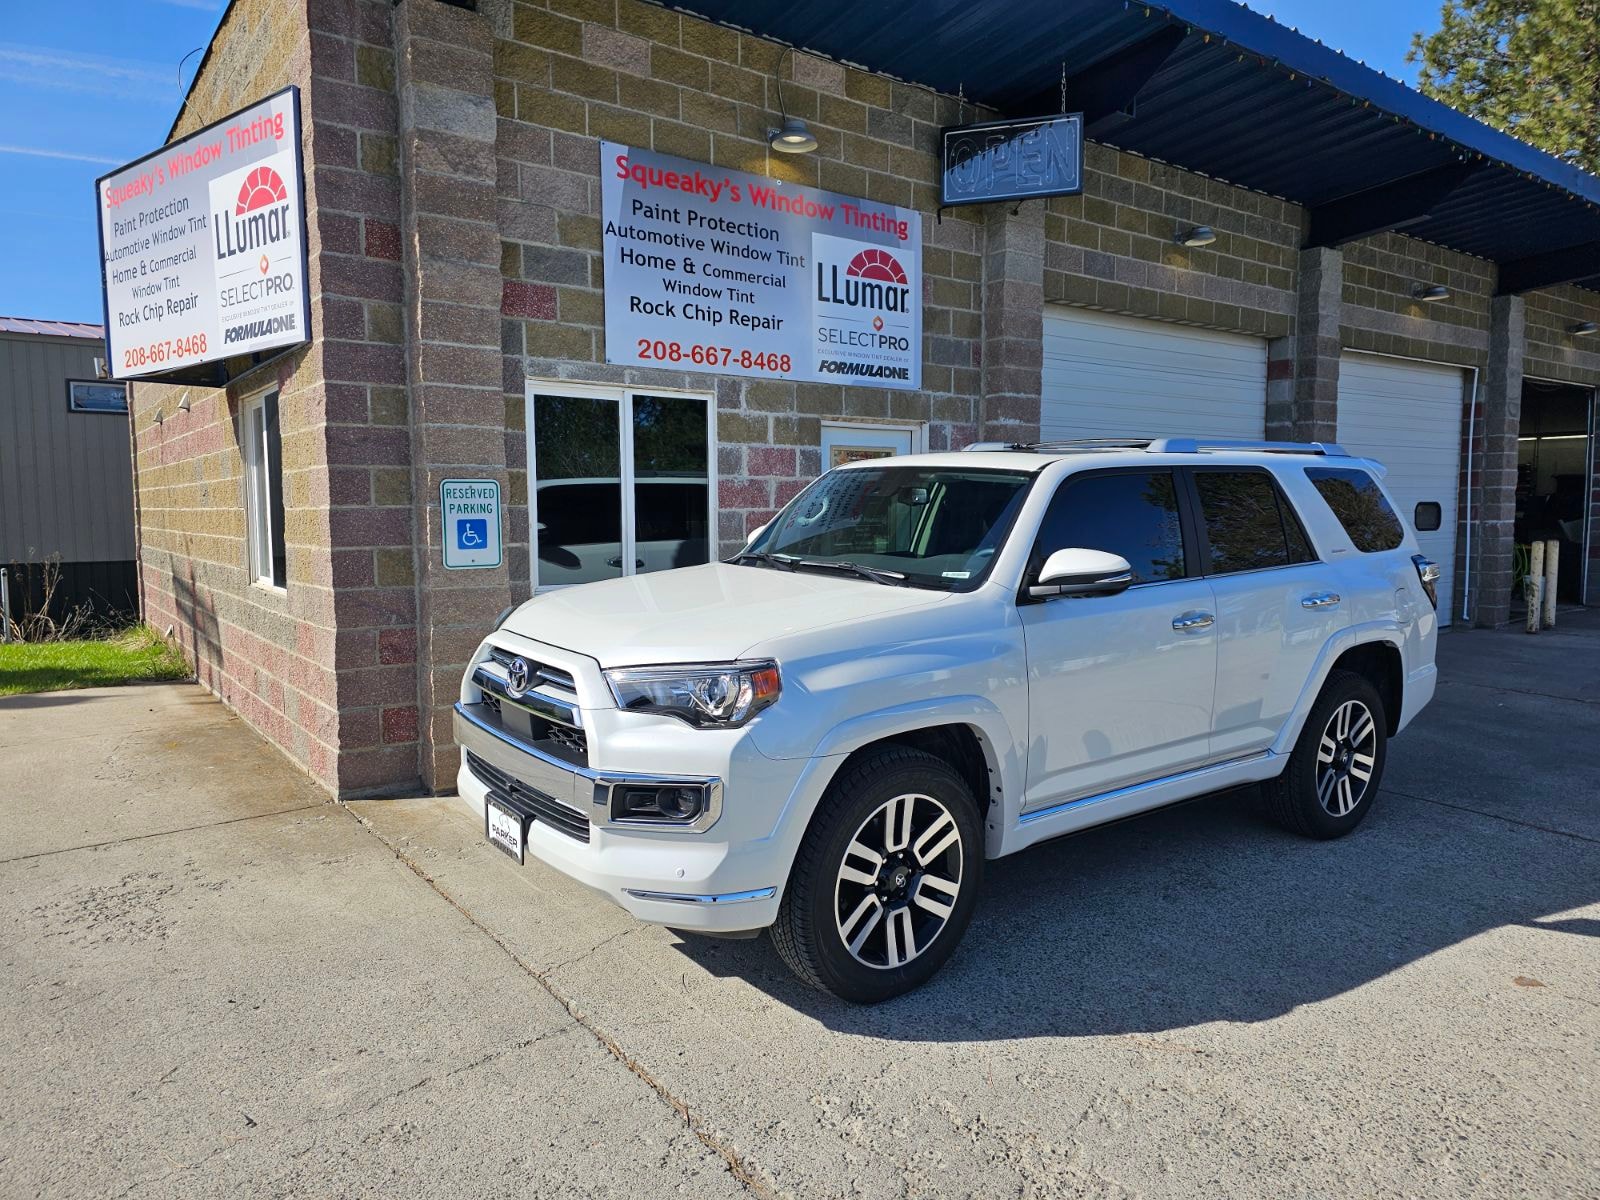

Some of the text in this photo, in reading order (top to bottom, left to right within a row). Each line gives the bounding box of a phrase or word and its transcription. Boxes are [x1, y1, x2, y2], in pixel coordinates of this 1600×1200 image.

[105, 112, 284, 208] Squeaky's Window Tinting
[949, 125, 1075, 192] OPEN
[114, 197, 189, 237] Paint Protection
[616, 155, 908, 240] Squeaky's Window Tinting
[105, 214, 207, 261] Automotive Window Tint
[215, 204, 289, 260] LLumar
[632, 199, 779, 241] Paint Protection
[605, 220, 805, 268] Automotive Window Tint
[112, 245, 196, 285] Home & Commercial
[620, 246, 786, 288] Home & Commercial
[132, 275, 180, 299] Window Tint
[663, 278, 755, 304] Window Tint
[817, 262, 910, 313] LLumar
[119, 308, 140, 327] Rock
[143, 302, 164, 322] Chip
[166, 292, 198, 316] Repair
[630, 296, 784, 331] Rock Chip Repair
[125, 333, 207, 367] 208-667-8468
[638, 339, 791, 372] 208-667-8468
[446, 488, 495, 499] RESERVED
[449, 503, 493, 514] PARKING
[492, 824, 518, 848] PARKER
